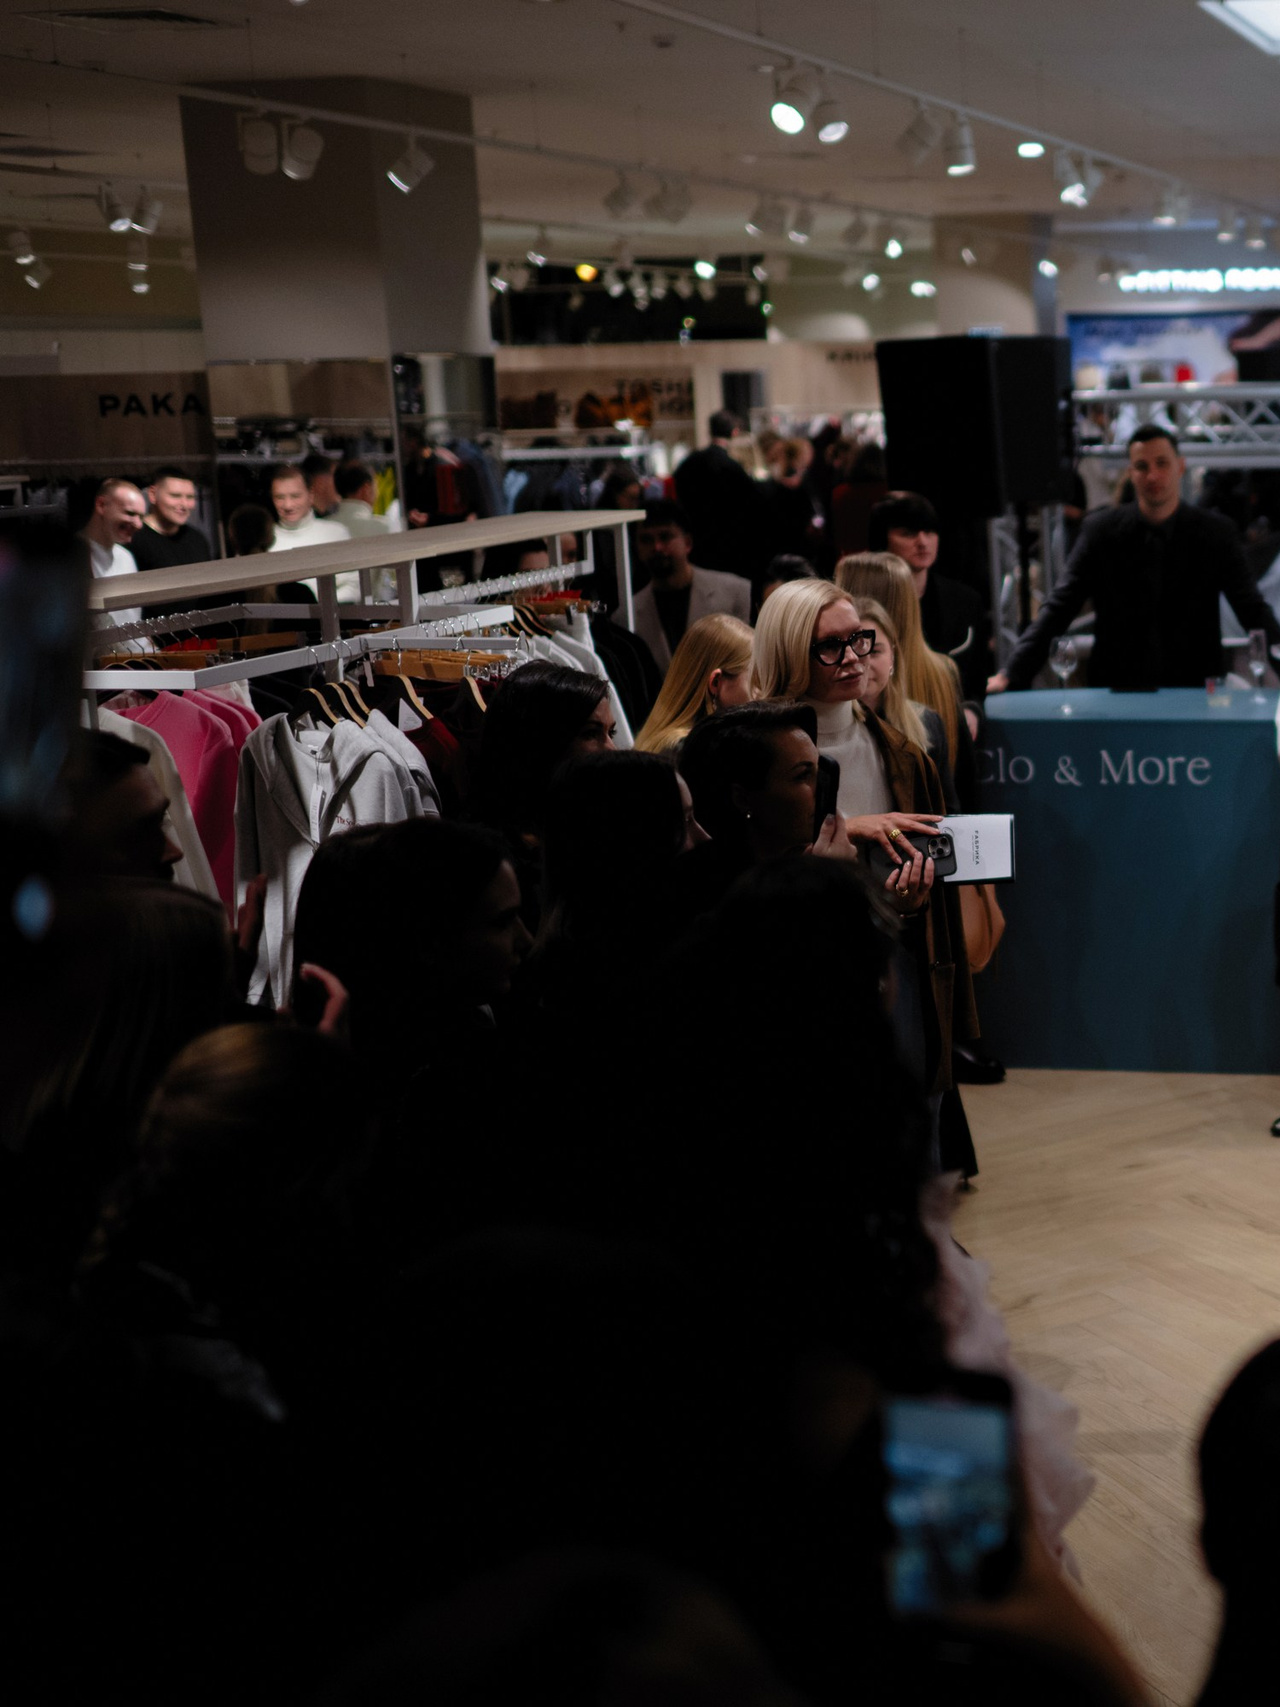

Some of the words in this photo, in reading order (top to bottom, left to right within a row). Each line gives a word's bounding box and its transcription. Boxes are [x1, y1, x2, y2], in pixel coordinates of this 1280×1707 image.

[99, 393, 206, 416] PAKA
[1053, 755, 1083, 786] &
[1099, 749, 1212, 785] More
